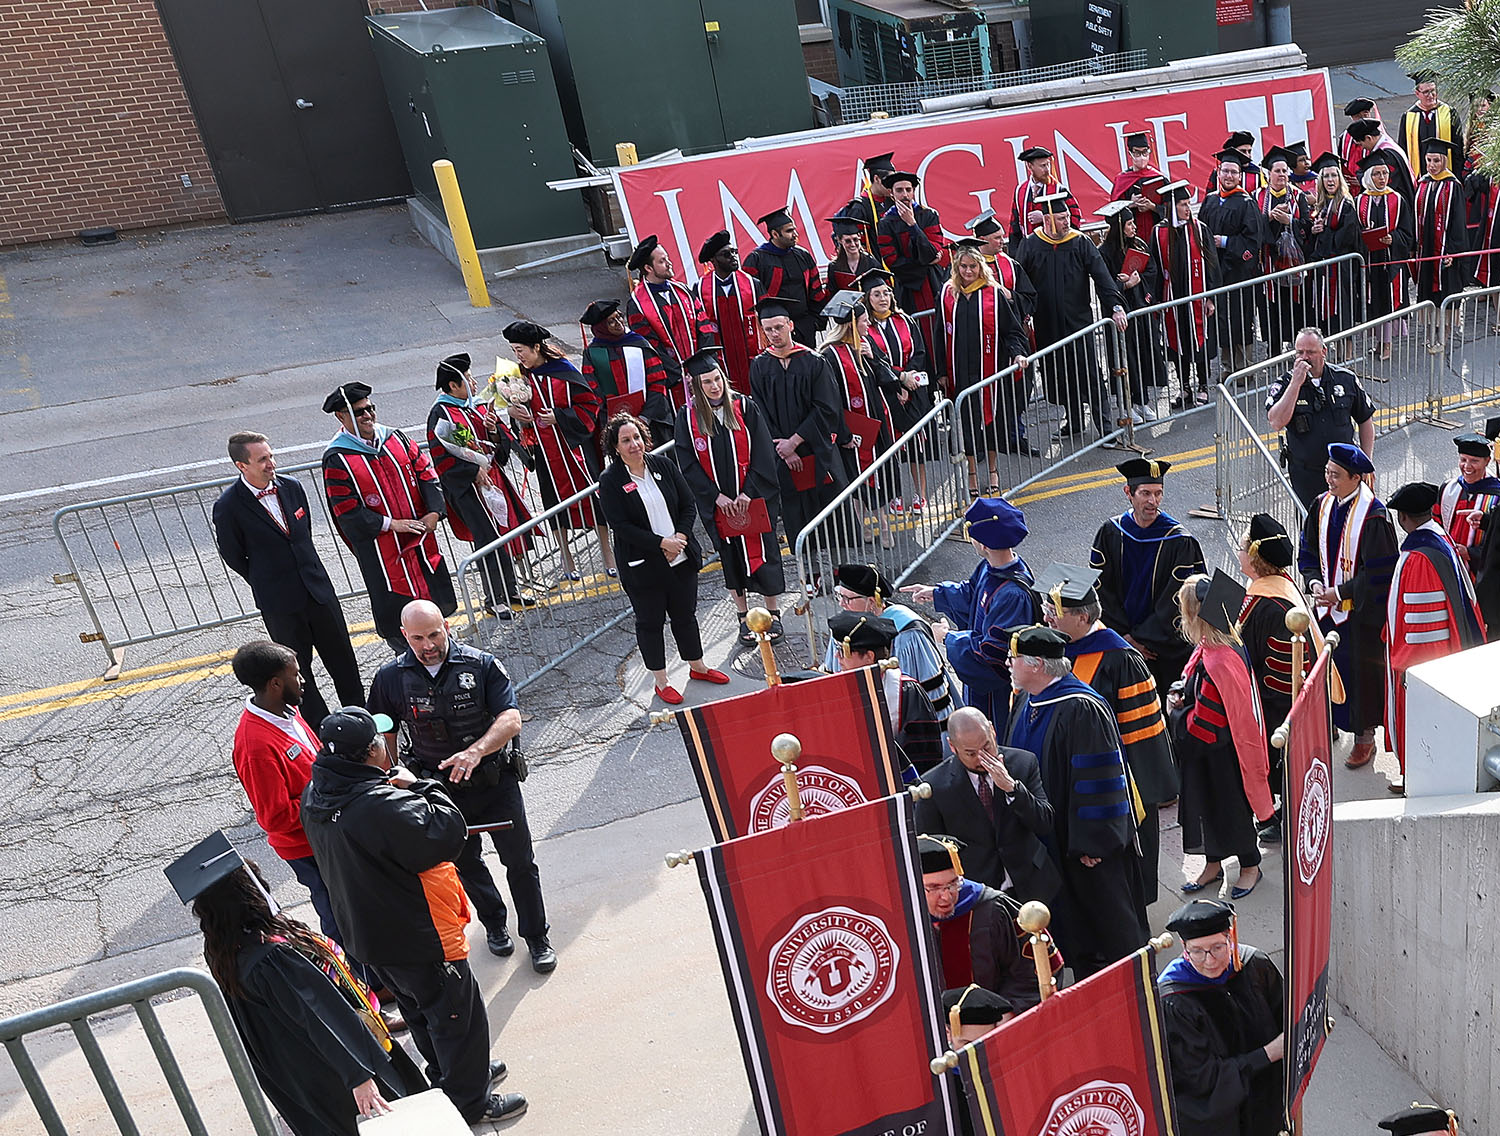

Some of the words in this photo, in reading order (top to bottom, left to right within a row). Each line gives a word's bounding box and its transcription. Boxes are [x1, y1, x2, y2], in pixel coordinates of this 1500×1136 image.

[1096, 16, 1102, 24] OF
[1090, 42, 1105, 54] POLICE
[454, 692, 472, 701] POLICE
[828, 780, 848, 794] OF
[844, 789, 860, 806] UT
[854, 921, 874, 937] OF
[778, 916, 854, 967] UNIVERSITY
[869, 931, 890, 968] UTAH
[776, 970, 789, 997] THE
[823, 1000, 863, 1023] 1850
[1107, 1092, 1122, 1107] OF
